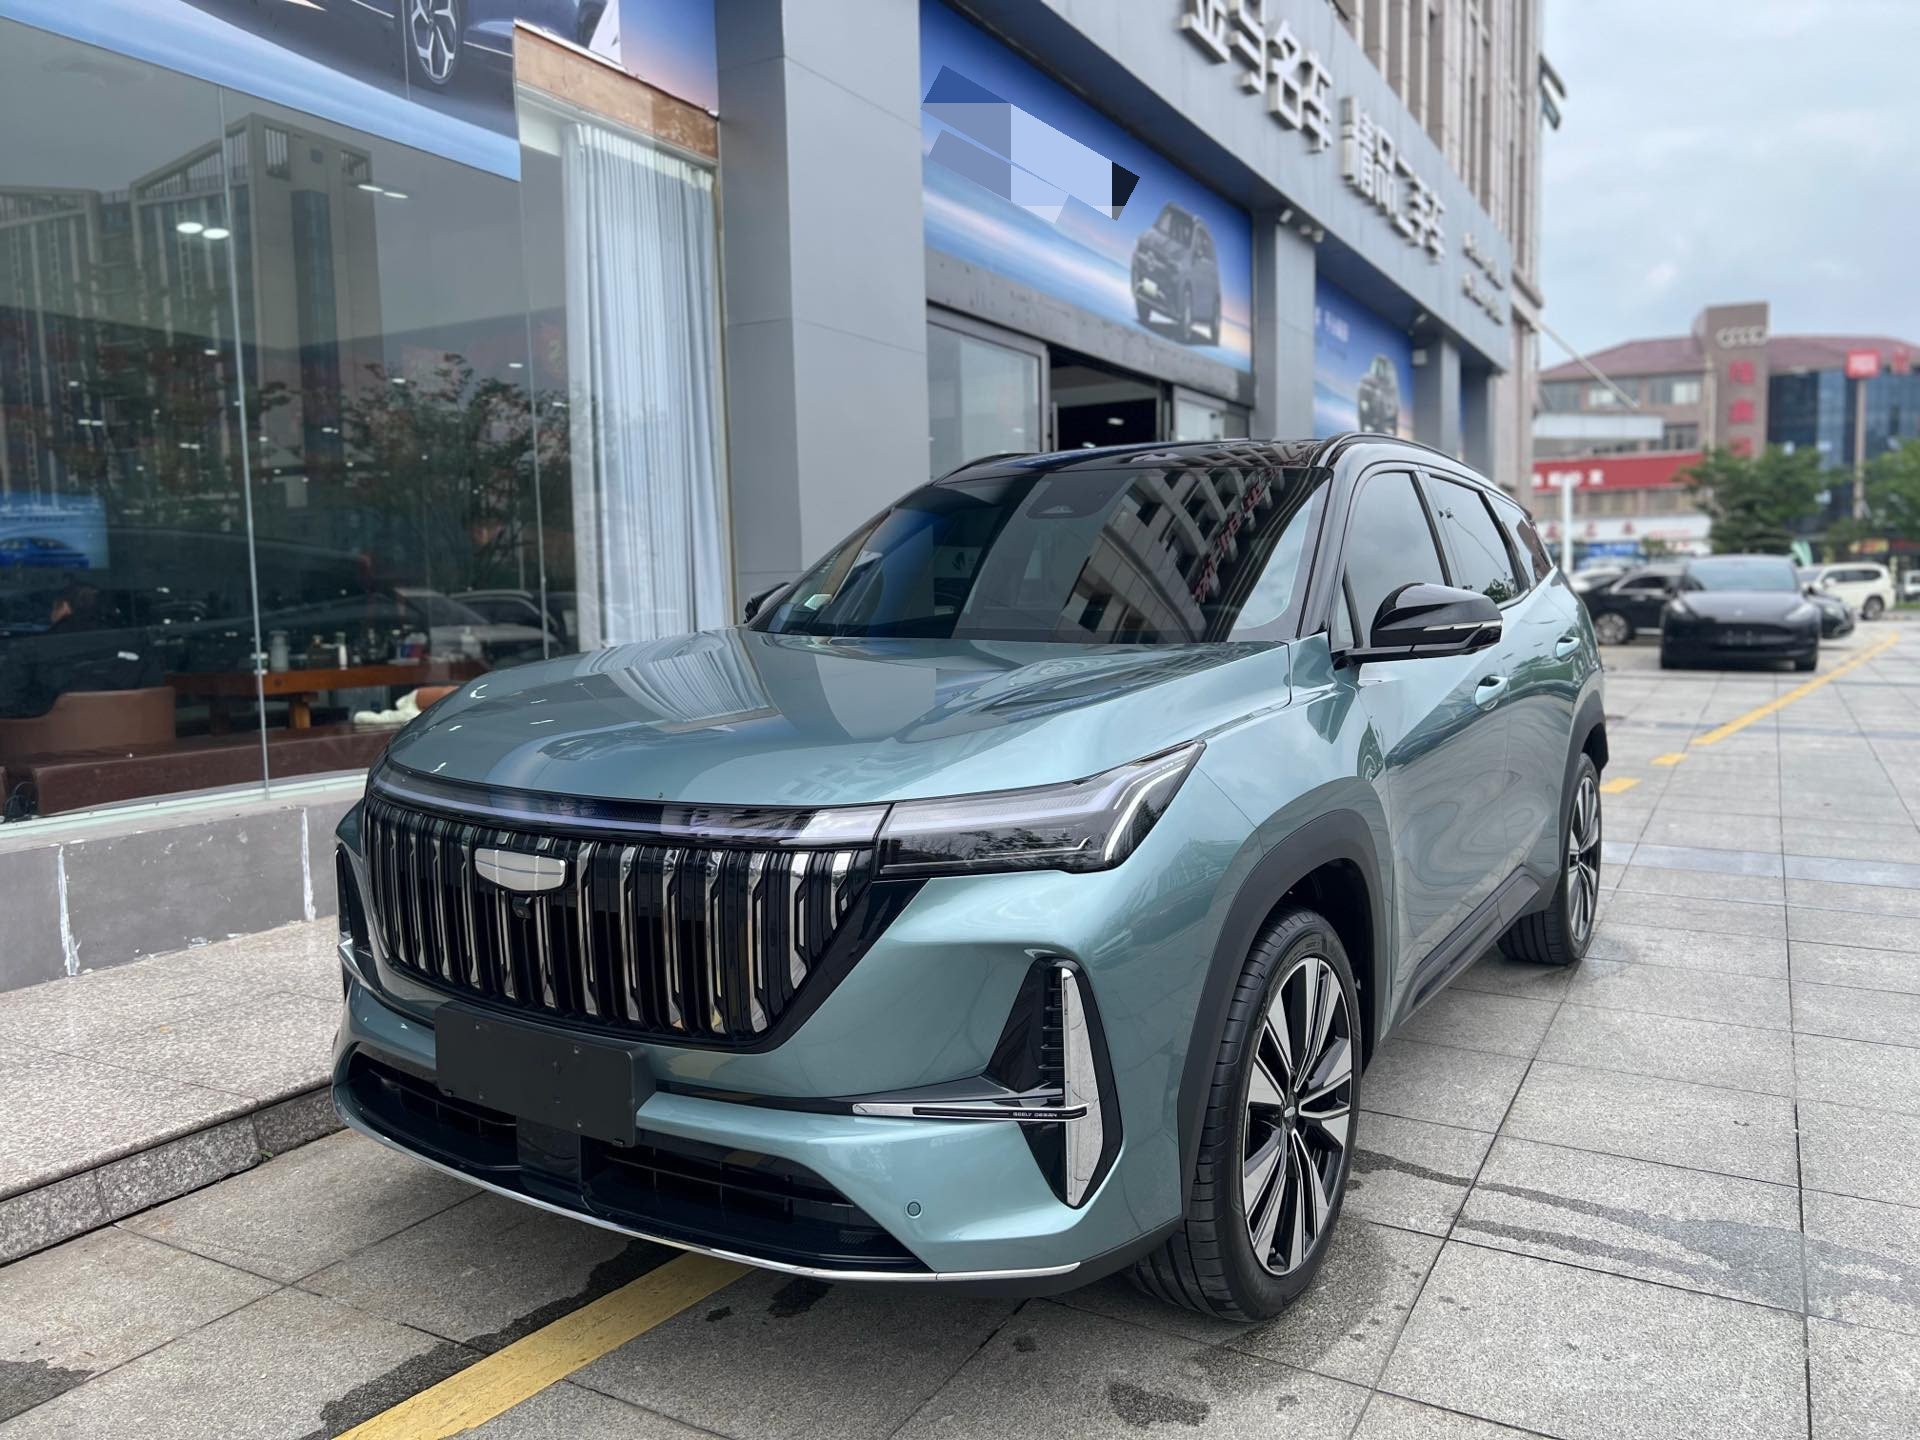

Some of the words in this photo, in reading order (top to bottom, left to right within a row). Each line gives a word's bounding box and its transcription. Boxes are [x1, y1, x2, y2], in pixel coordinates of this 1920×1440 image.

[1342, 96, 1446, 264] 精品二手车
